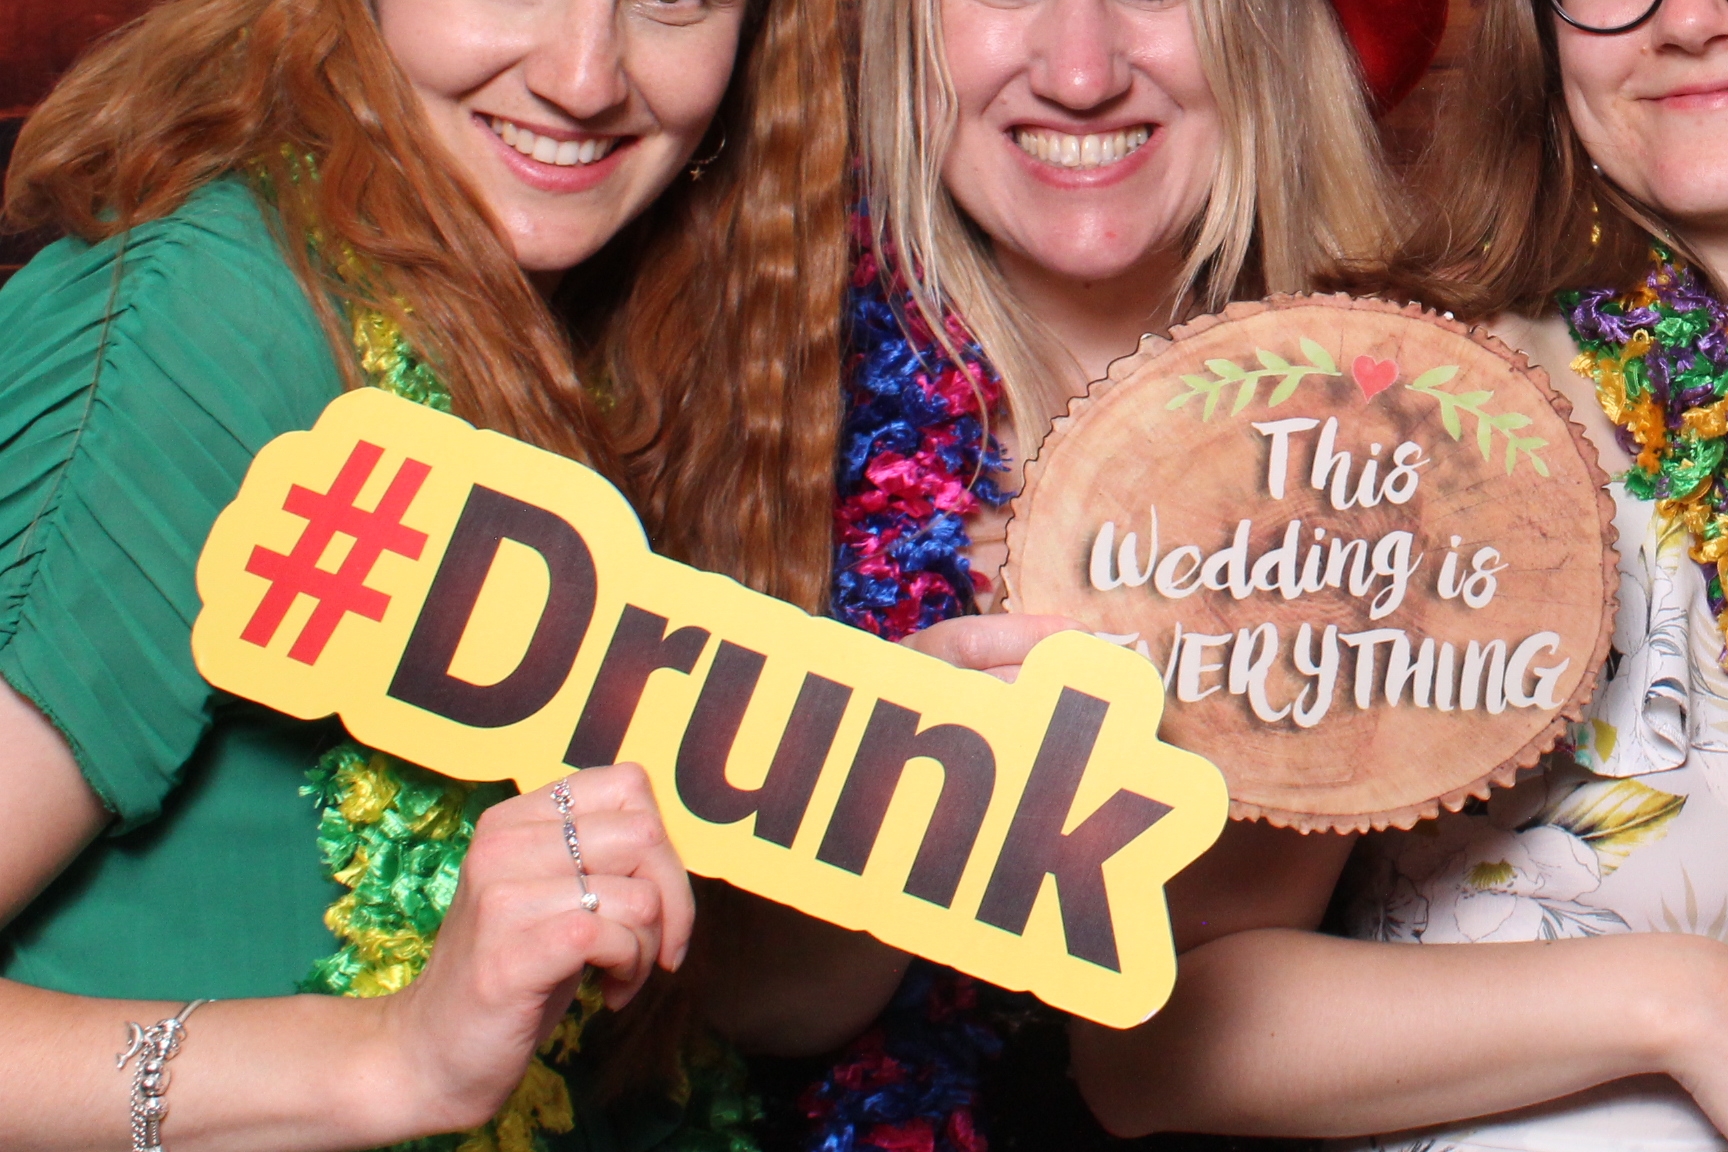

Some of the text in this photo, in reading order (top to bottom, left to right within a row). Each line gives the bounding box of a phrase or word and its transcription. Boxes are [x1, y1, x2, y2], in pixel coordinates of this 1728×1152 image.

[1251, 416, 1430, 510] This
[1090, 504, 1508, 620] Wedding is
[240, 440, 1173, 974] #Drunk
[1094, 621, 1570, 727] VERYTHING
